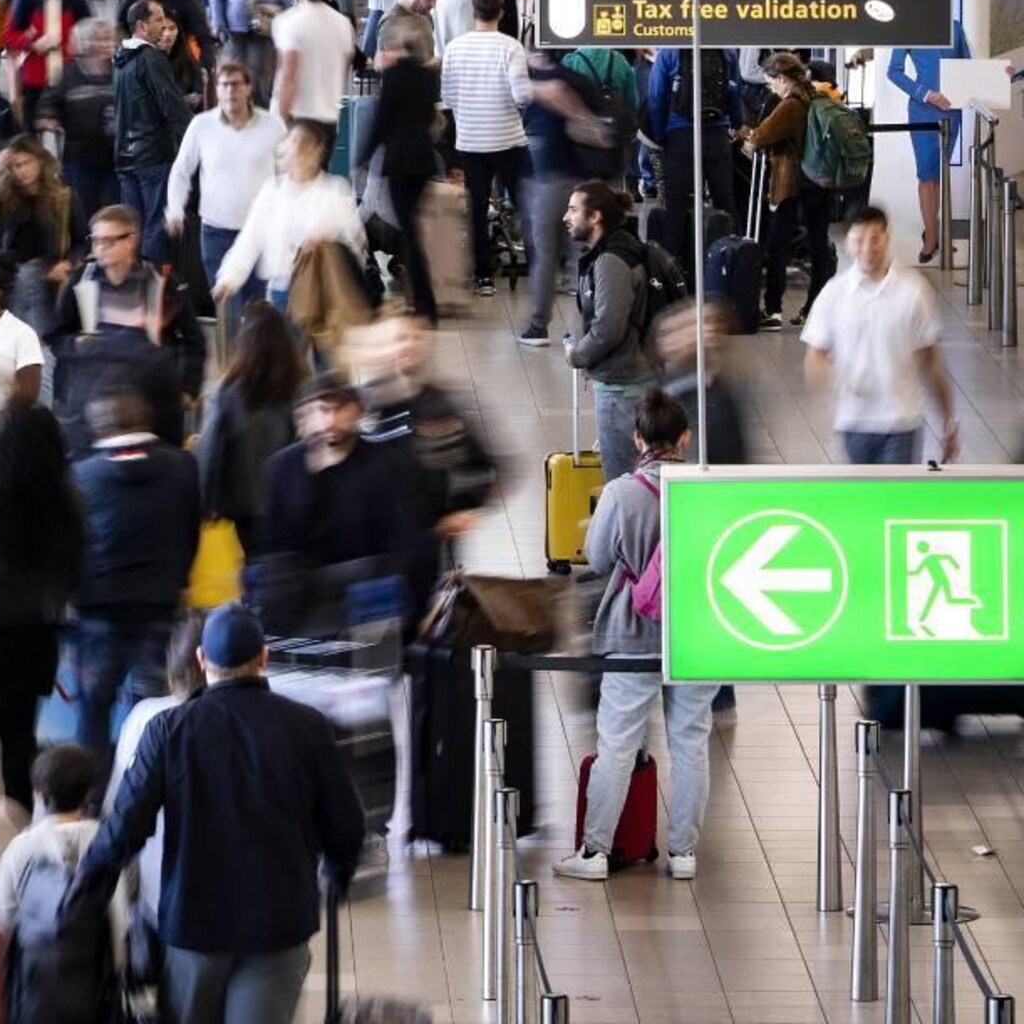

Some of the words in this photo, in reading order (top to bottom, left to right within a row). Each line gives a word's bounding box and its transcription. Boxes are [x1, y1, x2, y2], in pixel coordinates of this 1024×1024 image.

[632, 0, 672, 19] Tax
[681, 0, 728, 19] fee
[737, 0, 857, 19] validation
[633, 24, 695, 36] Customs
